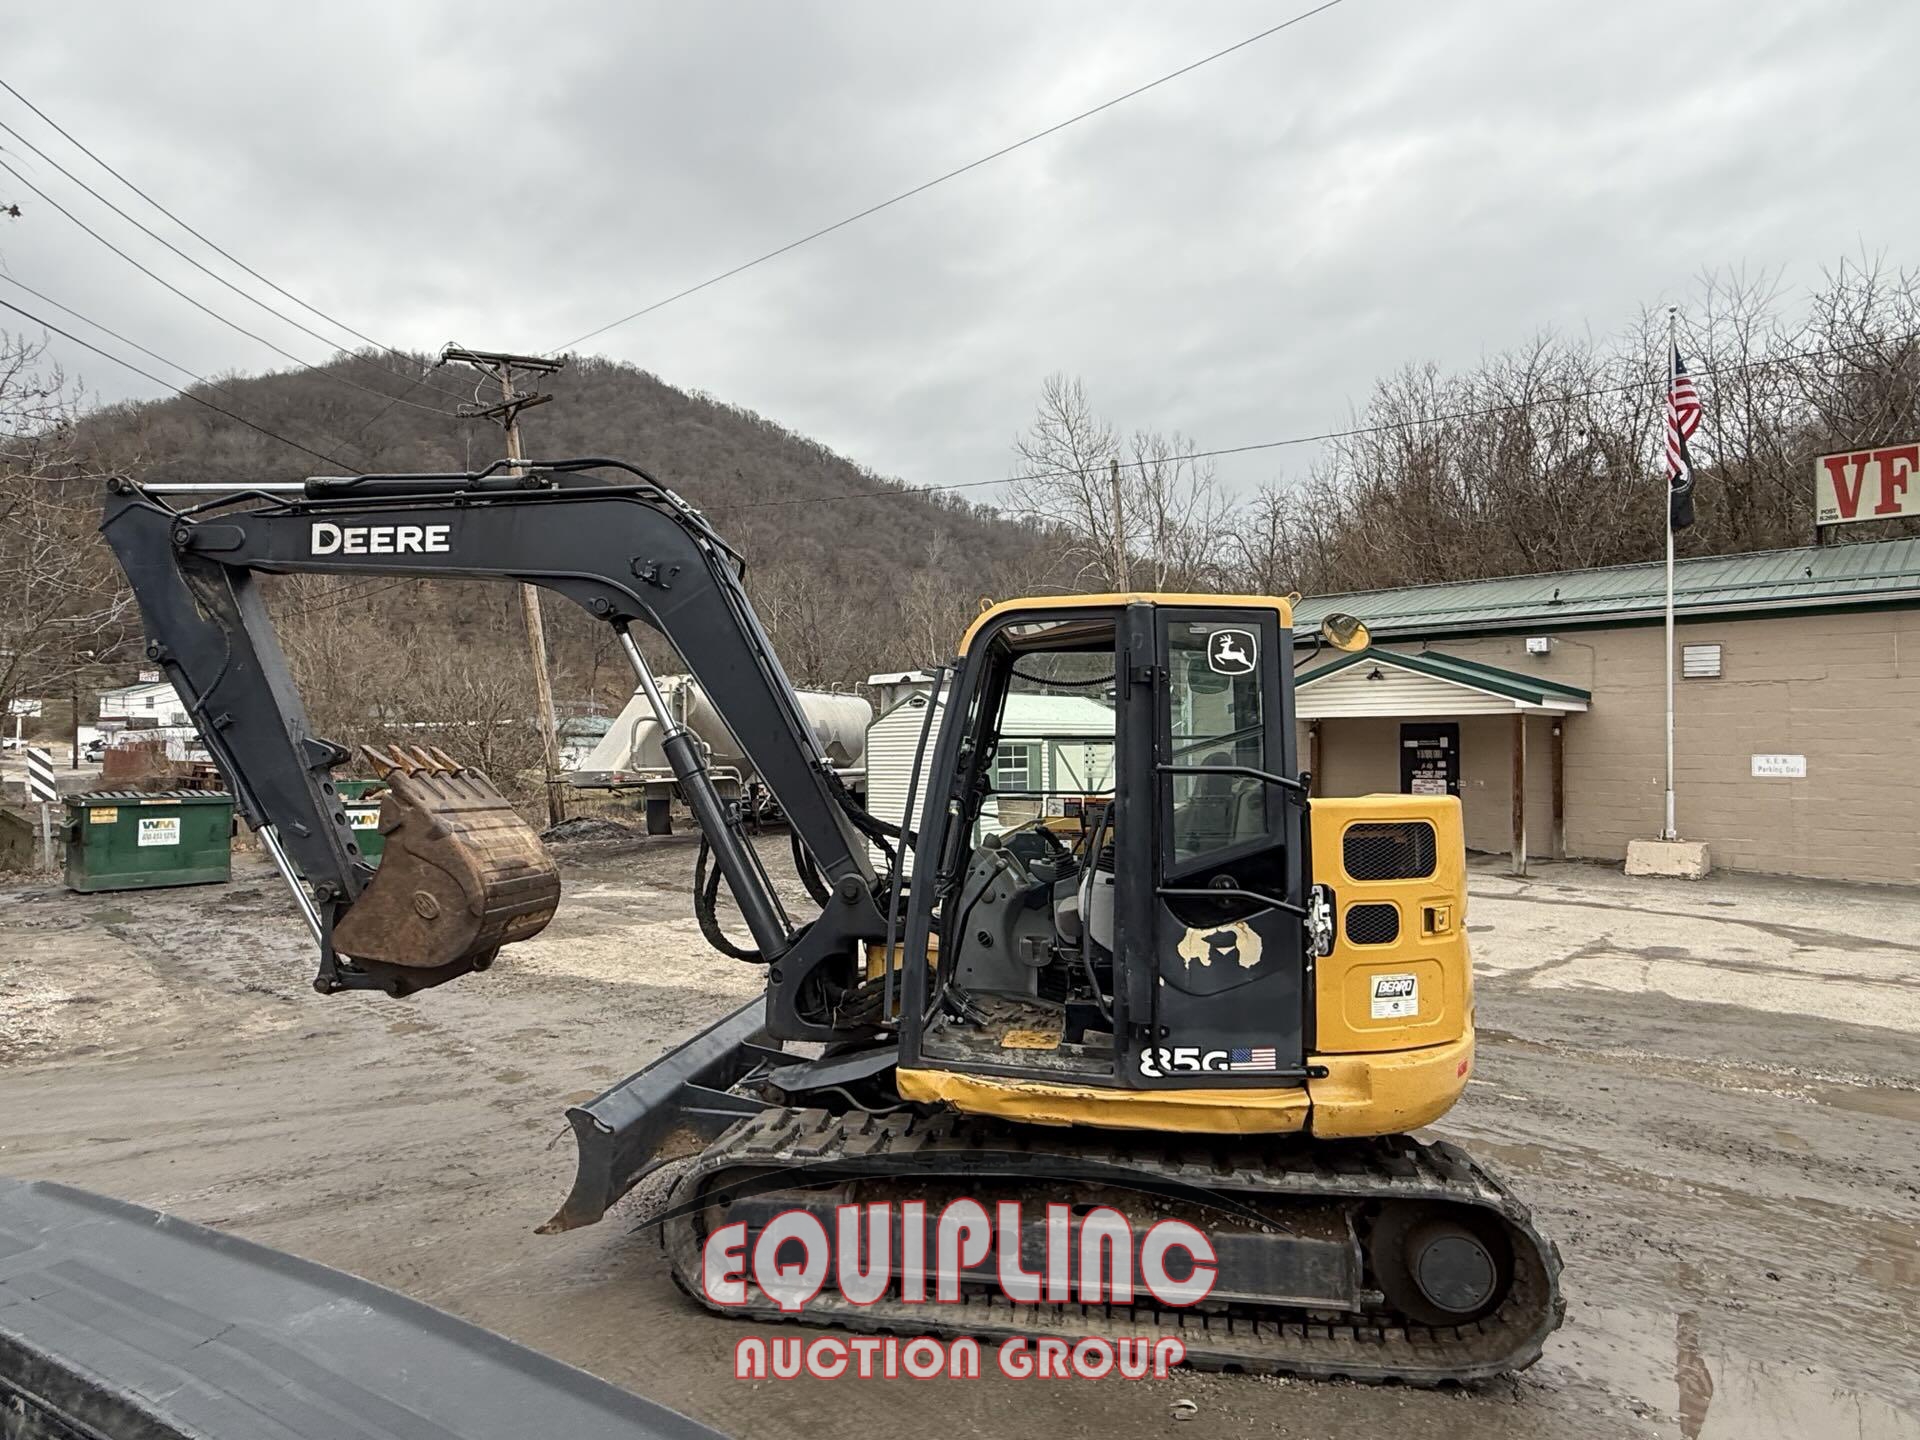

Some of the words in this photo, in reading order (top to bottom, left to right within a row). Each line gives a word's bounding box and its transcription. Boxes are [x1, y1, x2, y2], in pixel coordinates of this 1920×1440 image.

[1824, 446, 1919, 518] VF
[312, 523, 450, 555] DEERE
[1758, 766, 1783, 774] Parking
[142, 820, 176, 830] WM
[1378, 980, 1412, 995] BEARD
[1140, 1047, 1228, 1077] 85G
